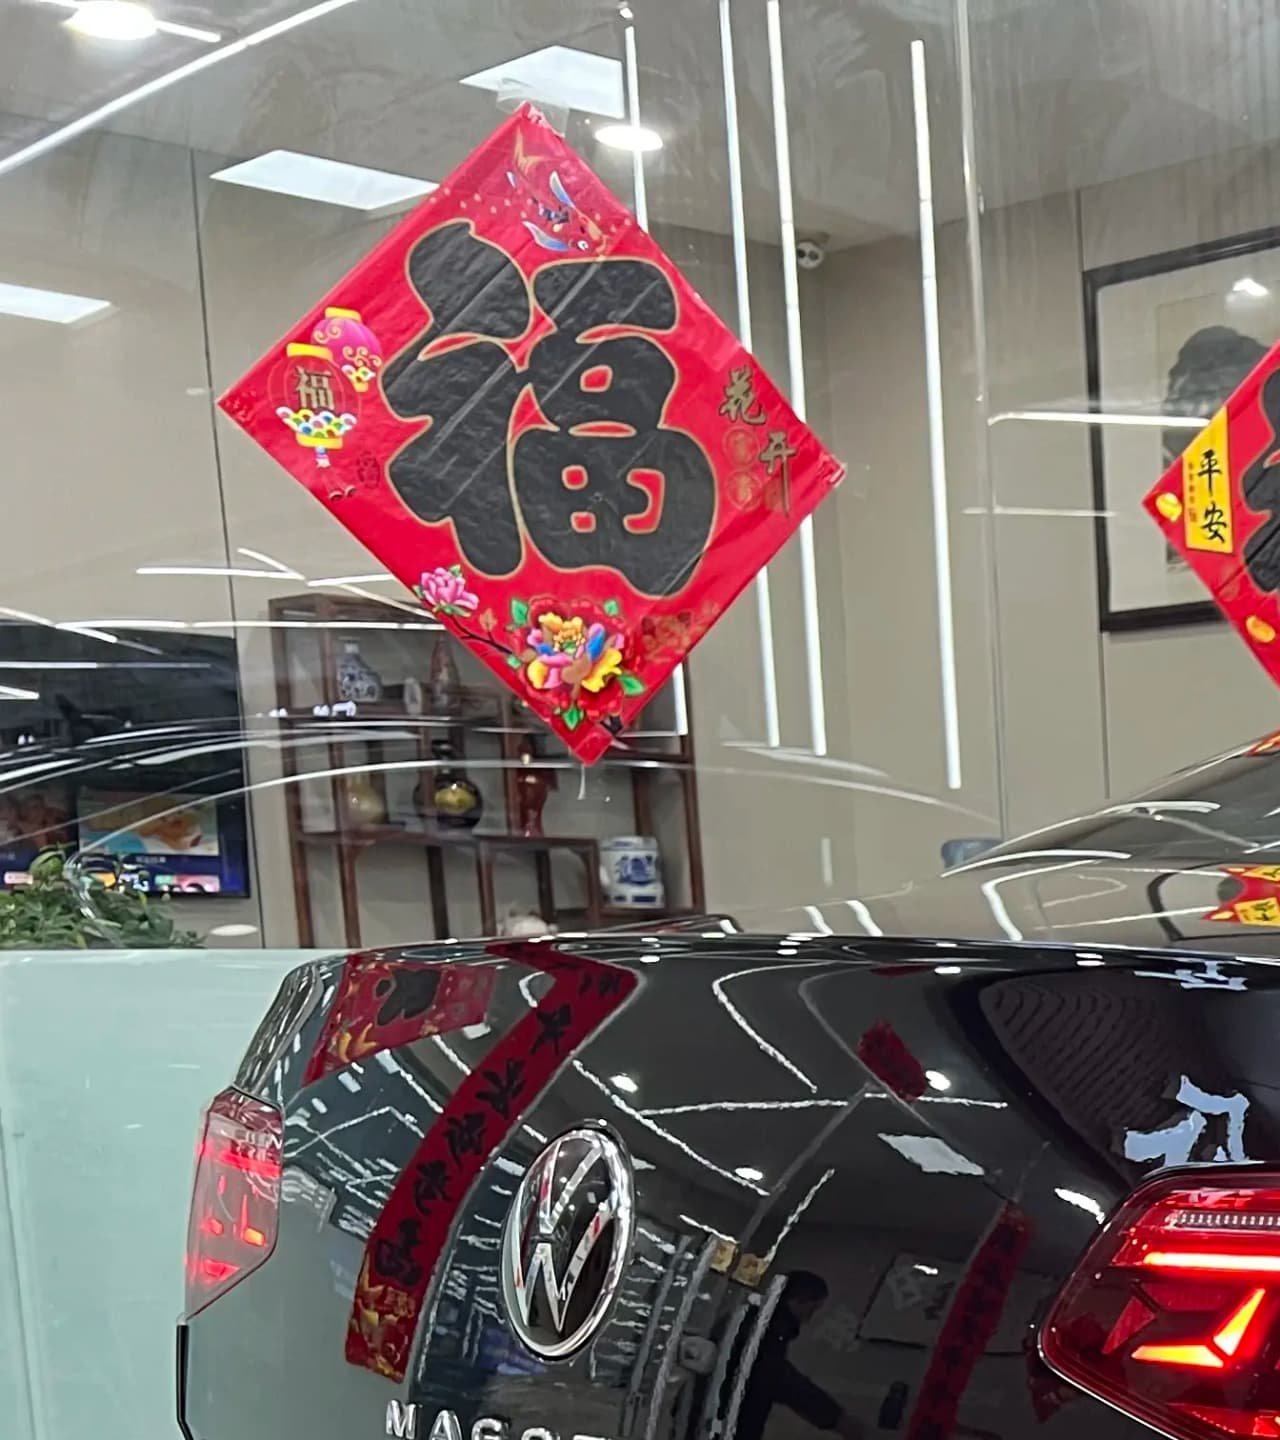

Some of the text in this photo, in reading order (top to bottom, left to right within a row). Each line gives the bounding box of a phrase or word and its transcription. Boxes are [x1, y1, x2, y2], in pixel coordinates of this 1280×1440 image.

[296, 365, 335, 412] 福
[379, 218, 718, 599] 福
[1197, 448, 1229, 544] 平安
